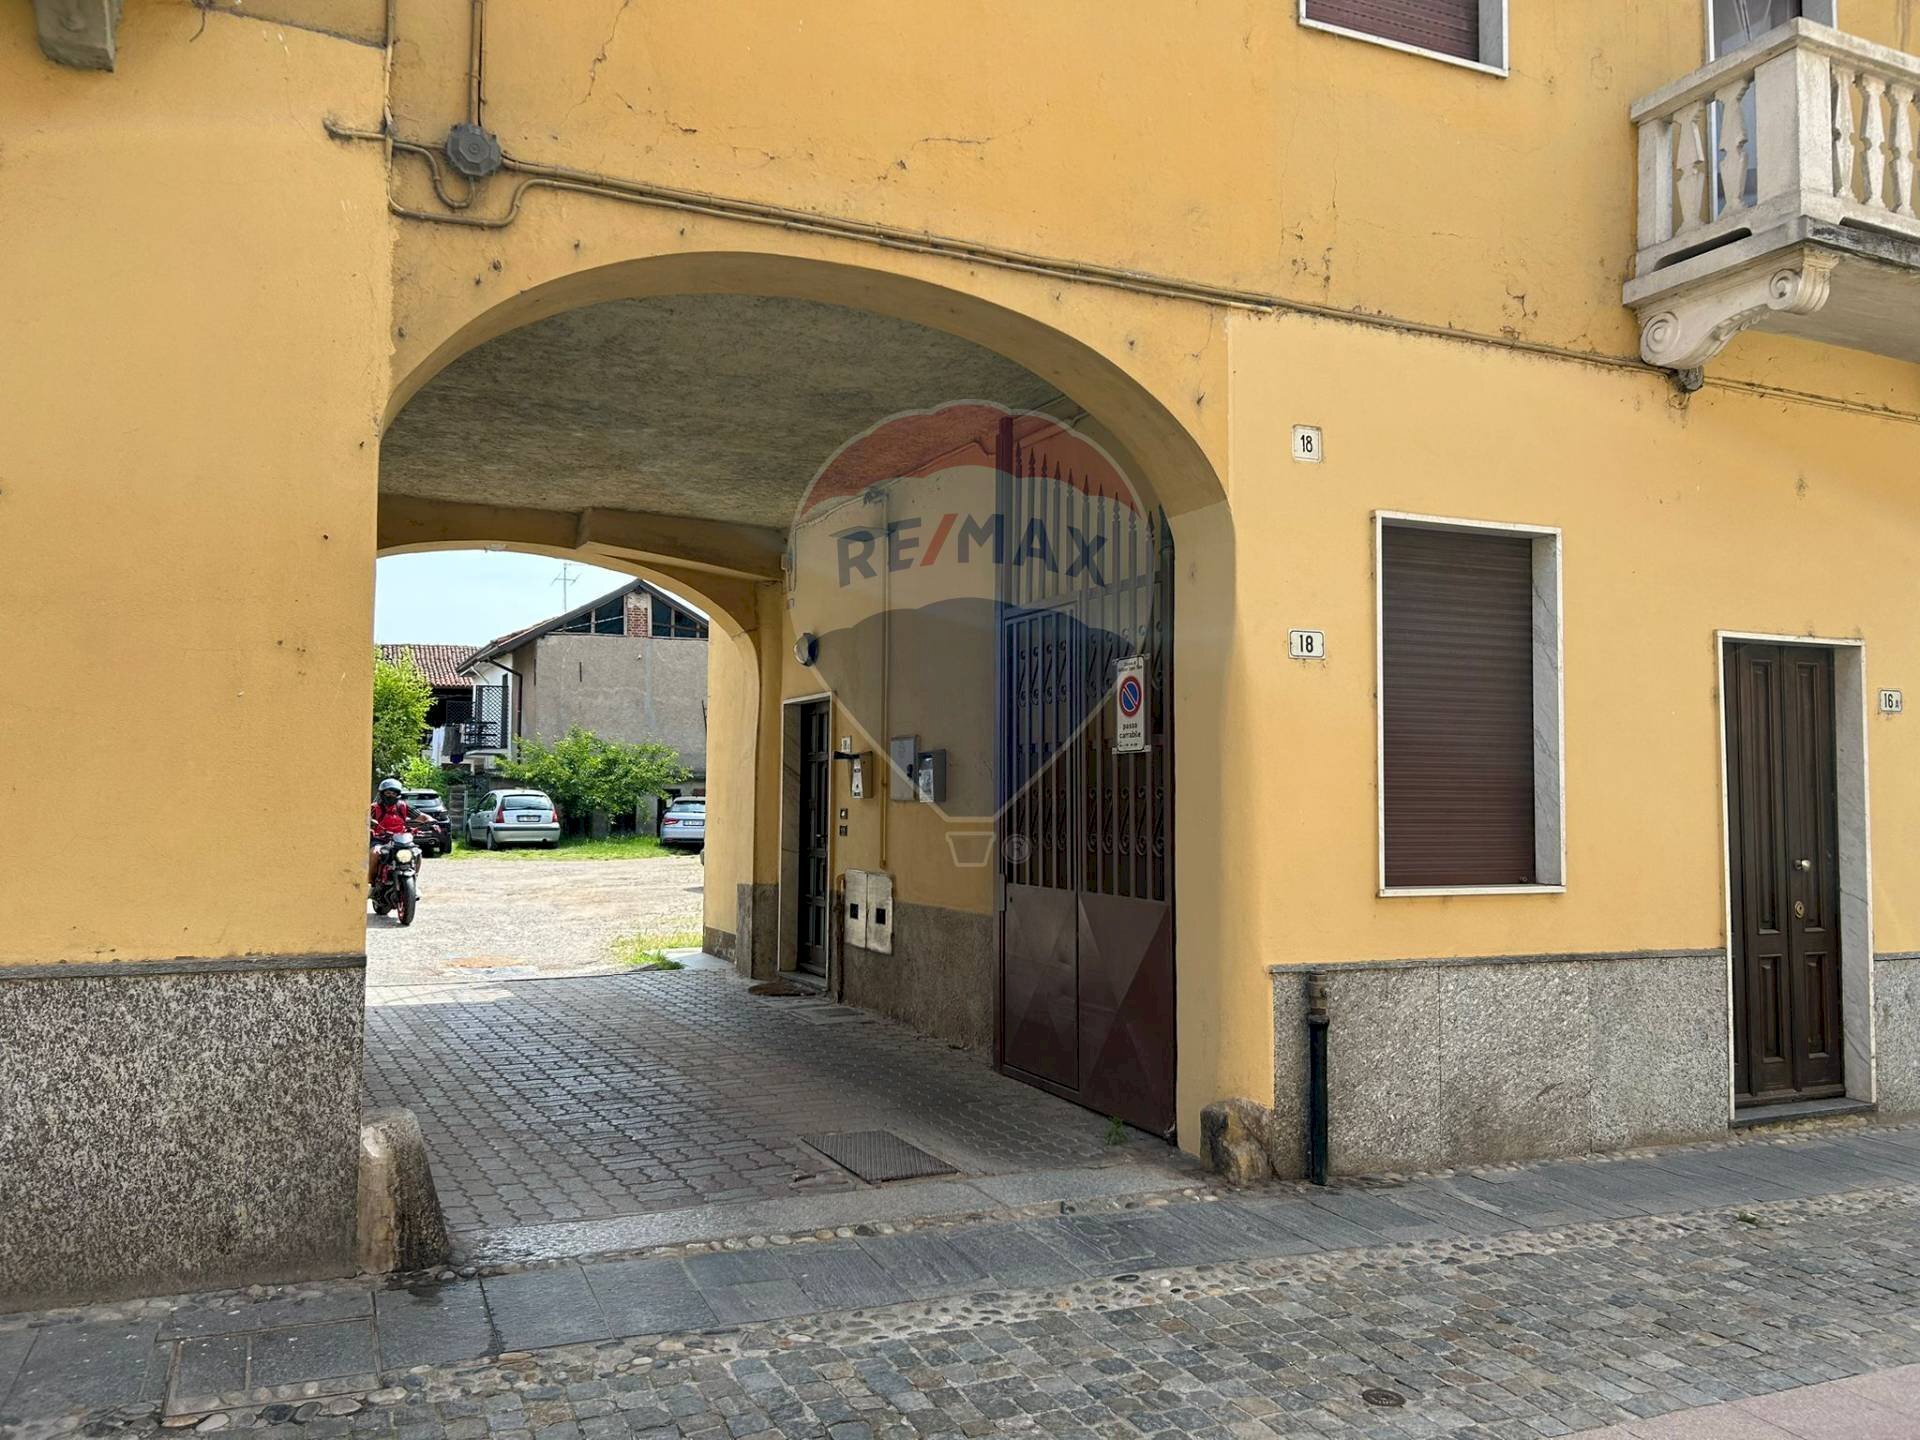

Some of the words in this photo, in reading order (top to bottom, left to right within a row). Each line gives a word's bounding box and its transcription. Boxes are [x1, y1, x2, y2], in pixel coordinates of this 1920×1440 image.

[1300, 434, 1313, 453] 18
[1299, 634, 1314, 653] 18
[1122, 722, 1138, 731] passo
[1119, 731, 1141, 739] carrabile
